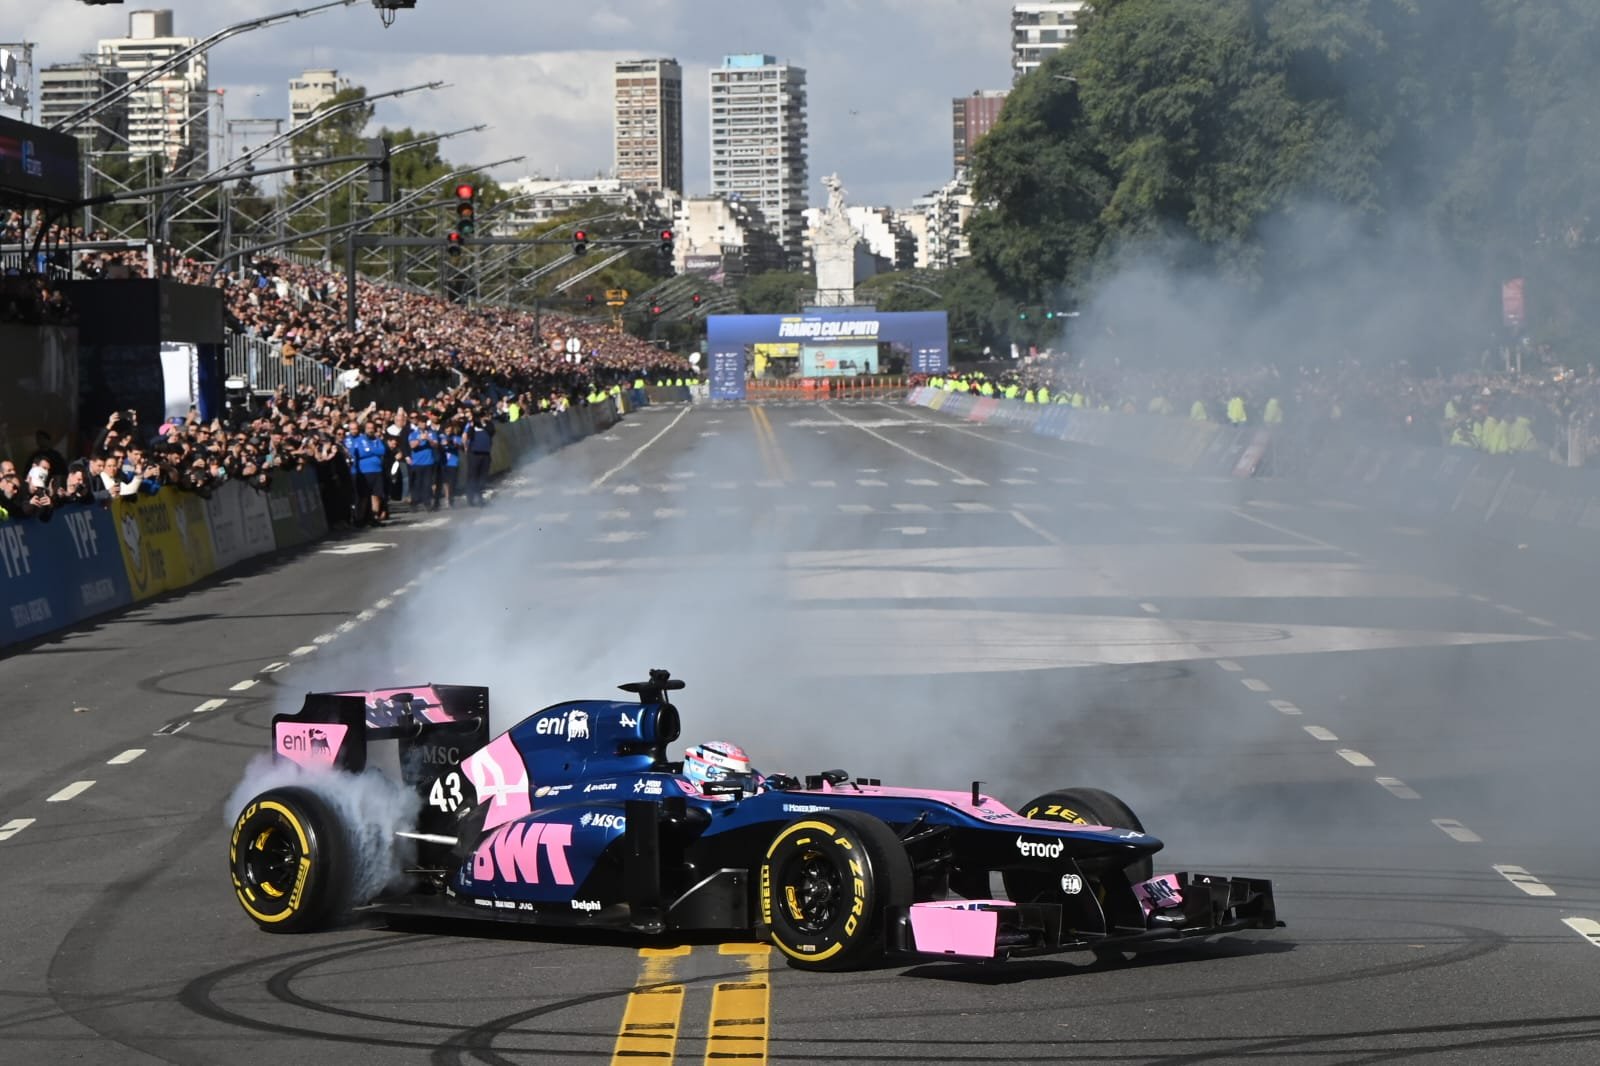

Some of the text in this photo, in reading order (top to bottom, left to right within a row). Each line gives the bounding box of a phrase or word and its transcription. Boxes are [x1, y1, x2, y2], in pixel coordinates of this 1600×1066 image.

[779, 321, 880, 336] FRANCO COLAPINTO
[64, 510, 98, 559] YPF
[536, 712, 568, 735] eni
[283, 730, 307, 751] eni
[423, 745, 460, 765] MSC
[429, 772, 463, 812] 43
[591, 813, 626, 830] MSC
[1044, 805, 1089, 825] ZER
[473, 822, 575, 886] BWT
[760, 864, 772, 925] PIRELLI
[834, 837, 865, 937] P ZERO
[571, 899, 601, 911] Delphi
